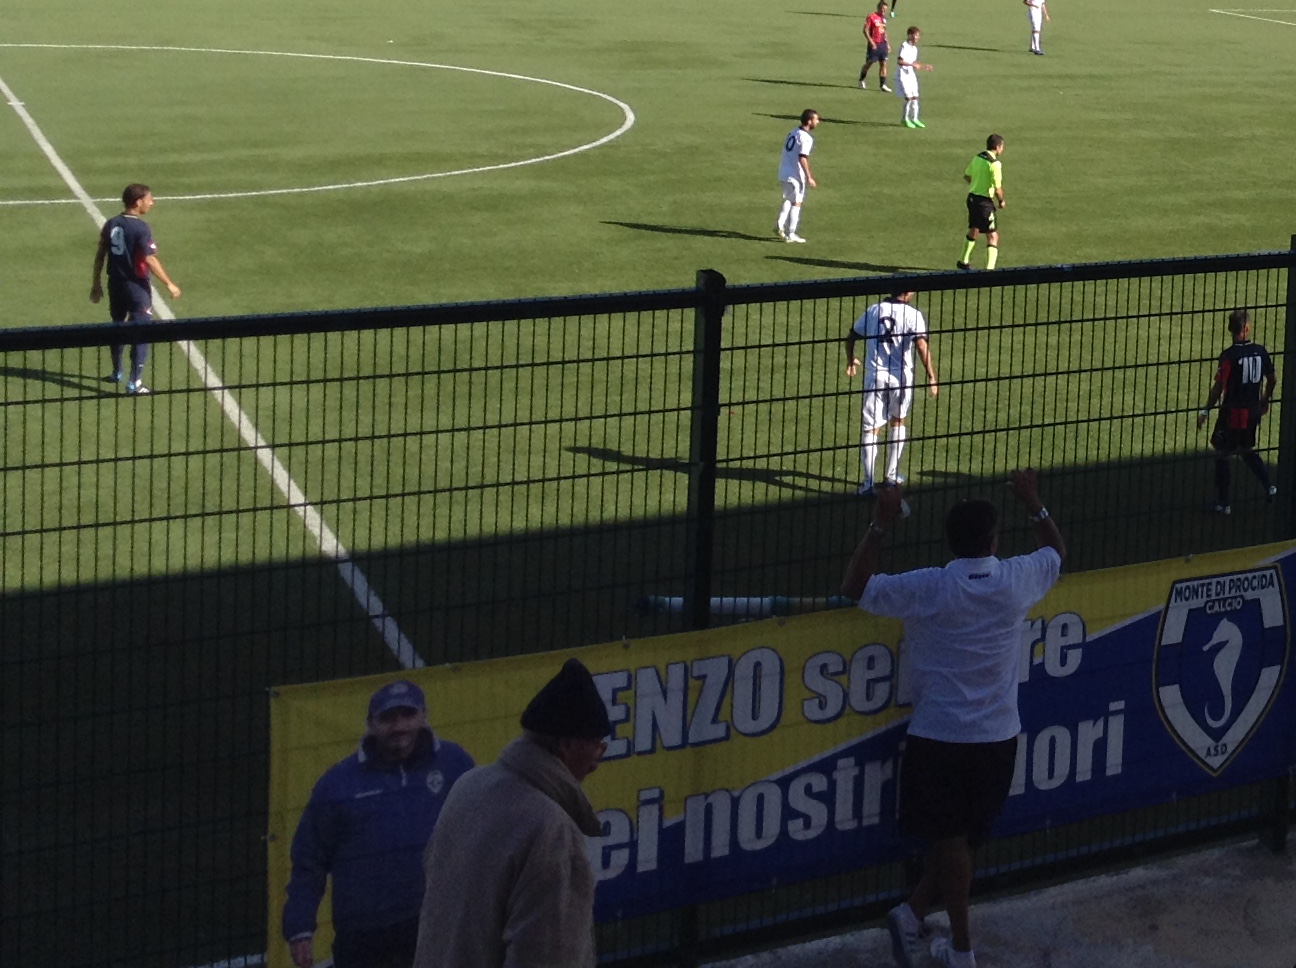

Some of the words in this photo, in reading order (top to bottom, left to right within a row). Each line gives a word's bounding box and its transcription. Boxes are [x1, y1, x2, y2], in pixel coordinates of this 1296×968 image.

[110, 226, 125, 256] 9
[1238, 355, 1262, 384] 10
[1174, 581, 1213, 603] MONTE
[1214, 580, 1226, 597] DI
[1228, 572, 1275, 594] PROCIDA
[1205, 596, 1243, 615] CALCIO
[592, 645, 784, 762] ENZO
[802, 611, 1086, 725] sere
[584, 786, 664, 882] ei
[684, 739, 908, 865] nostr
